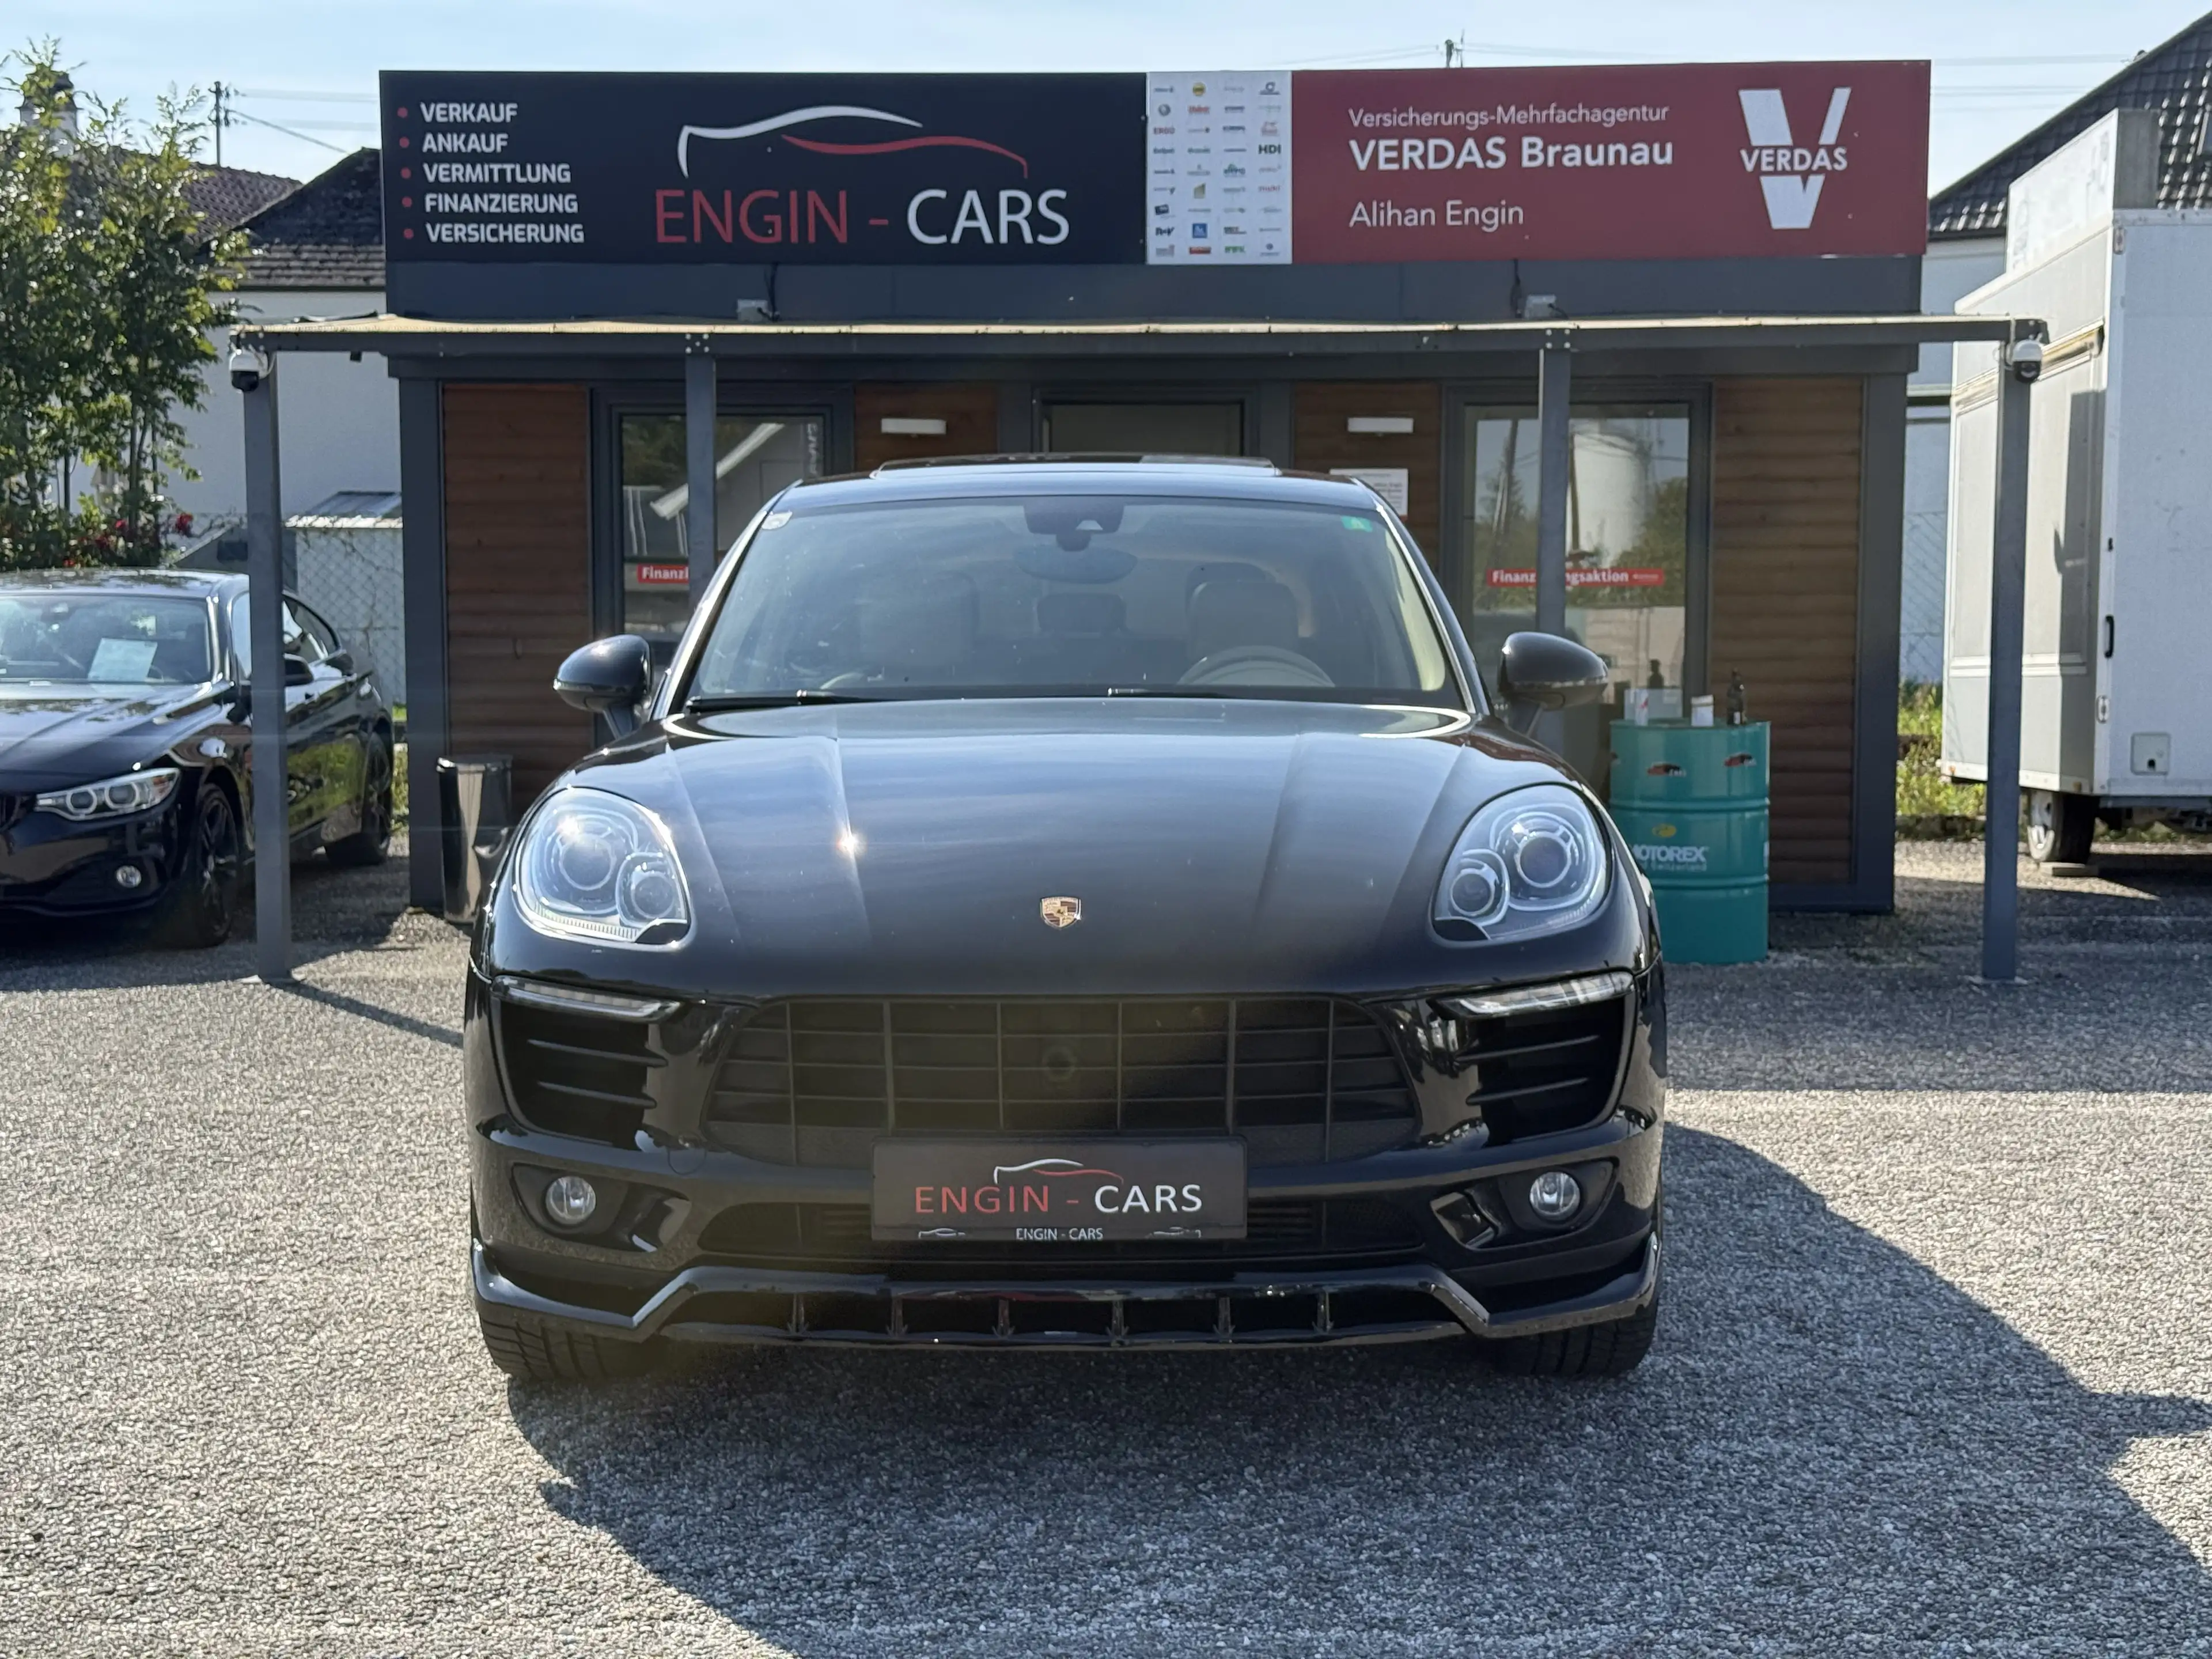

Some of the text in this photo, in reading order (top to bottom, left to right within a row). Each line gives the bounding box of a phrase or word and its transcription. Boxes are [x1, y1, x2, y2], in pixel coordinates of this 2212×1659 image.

[420, 102, 518, 123] VERKAUF
[1349, 102, 1670, 131] Versicherungs-Mehrfachagentur
[422, 132, 509, 153] ANKAUF
[1258, 144, 1282, 154] HDI
[1349, 136, 1673, 171] VERDAS Braunau
[1740, 147, 1848, 172] VERDAS
[423, 163, 571, 184] VERMITTLUNG
[425, 193, 578, 214] FINANZIERUNG
[655, 189, 848, 244] ENGIN
[907, 189, 1070, 245] CARS
[1349, 199, 1524, 233] Alihan Engin
[426, 223, 584, 243] VERSICHERUNG
[915, 1185, 1049, 1214] ENGIN
[1094, 1184, 1203, 1213] CARS
[1016, 1228, 1058, 1241] ENGIN
[1069, 1228, 1104, 1241] CARS
